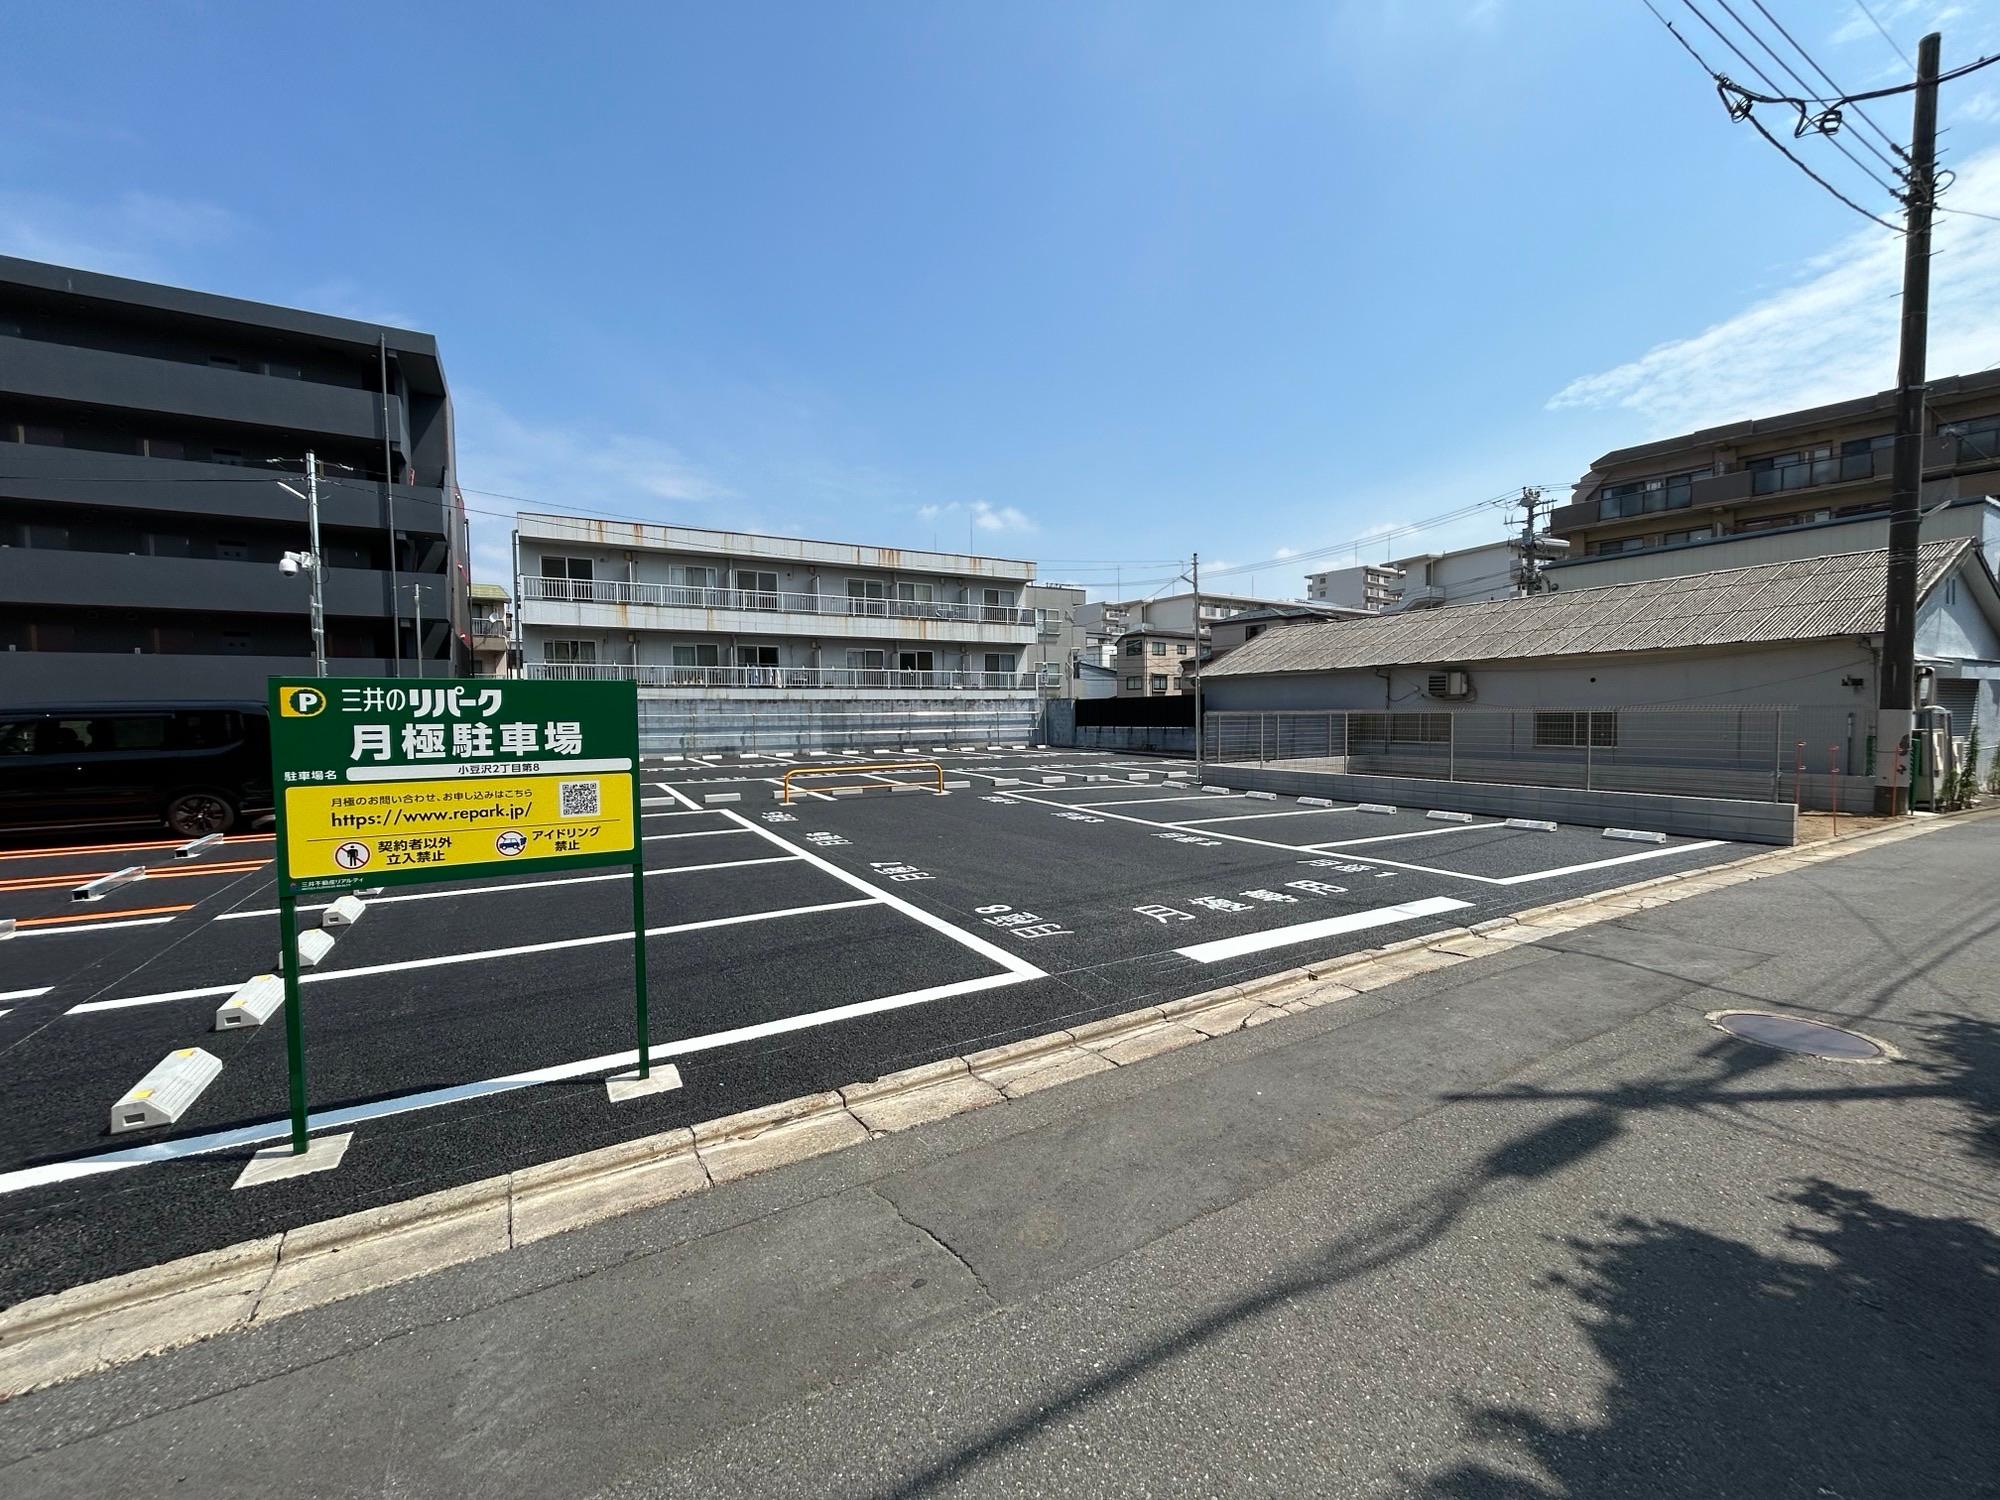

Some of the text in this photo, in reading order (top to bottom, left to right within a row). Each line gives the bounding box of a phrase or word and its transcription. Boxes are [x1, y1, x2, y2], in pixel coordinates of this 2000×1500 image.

[299, 692, 319, 712] P
[341, 686, 502, 718] 三井のリパーク
[350, 721, 583, 761] 月極駐車場
[284, 770, 337, 782] 駐車場名
[457, 763, 540, 775] 小豆沢2丁目第8
[331, 788, 533, 808] 月極のお問い合わせ、お申し込みはこちら
[331, 802, 532, 830] https://www.repark.jp/
[532, 826, 601, 841] アイドリング
[378, 836, 452, 853] 契約者以外
[555, 840, 580, 852] 禁止
[386, 850, 446, 866] 立入禁止
